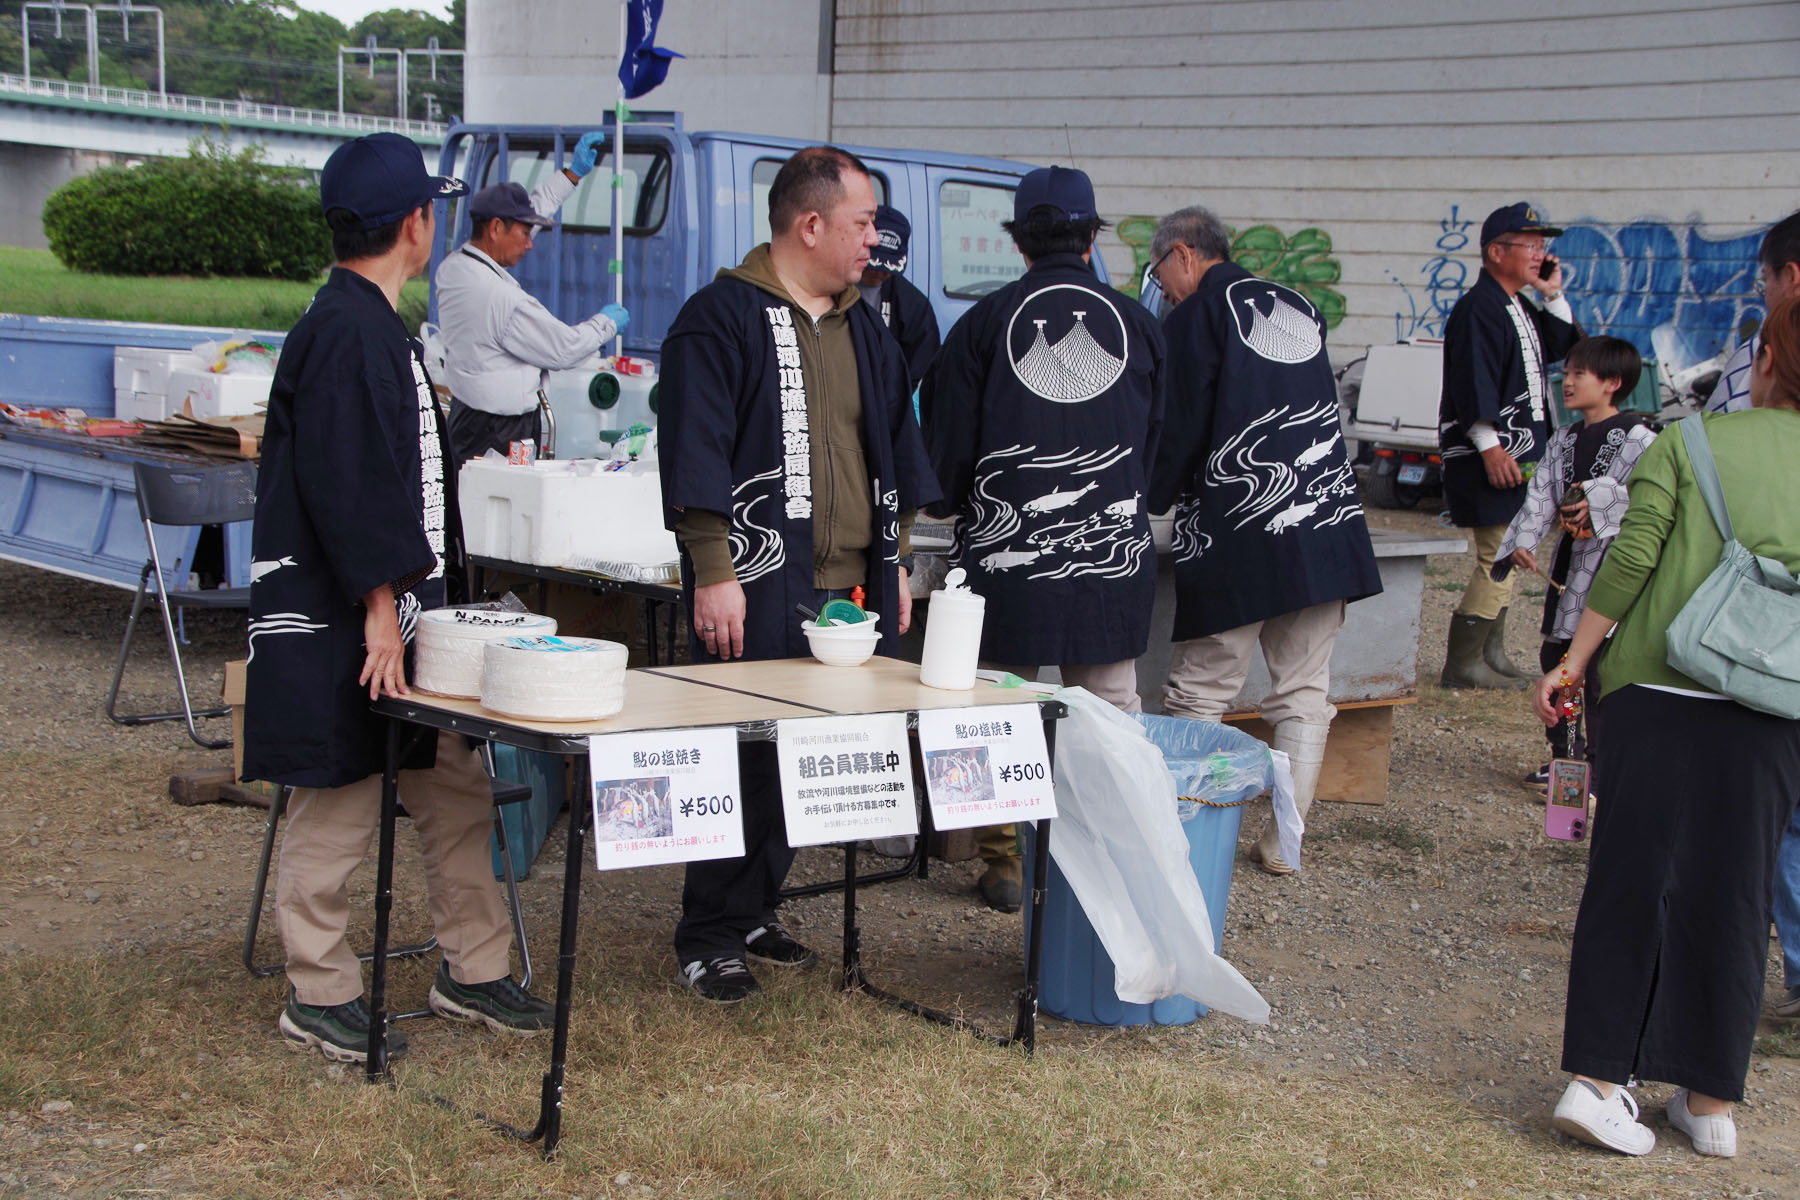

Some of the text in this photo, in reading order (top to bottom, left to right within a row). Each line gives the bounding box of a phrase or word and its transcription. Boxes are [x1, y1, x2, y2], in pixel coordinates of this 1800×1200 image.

[411, 349, 446, 580] 崎河川漁業協同組
[798, 750, 900, 779] 組合員募集中
[999, 762, 1045, 783] ¥500
[797, 782, 905, 799] 放流や河川環境整備などの活動を
[679, 794, 734, 818] ¥500
